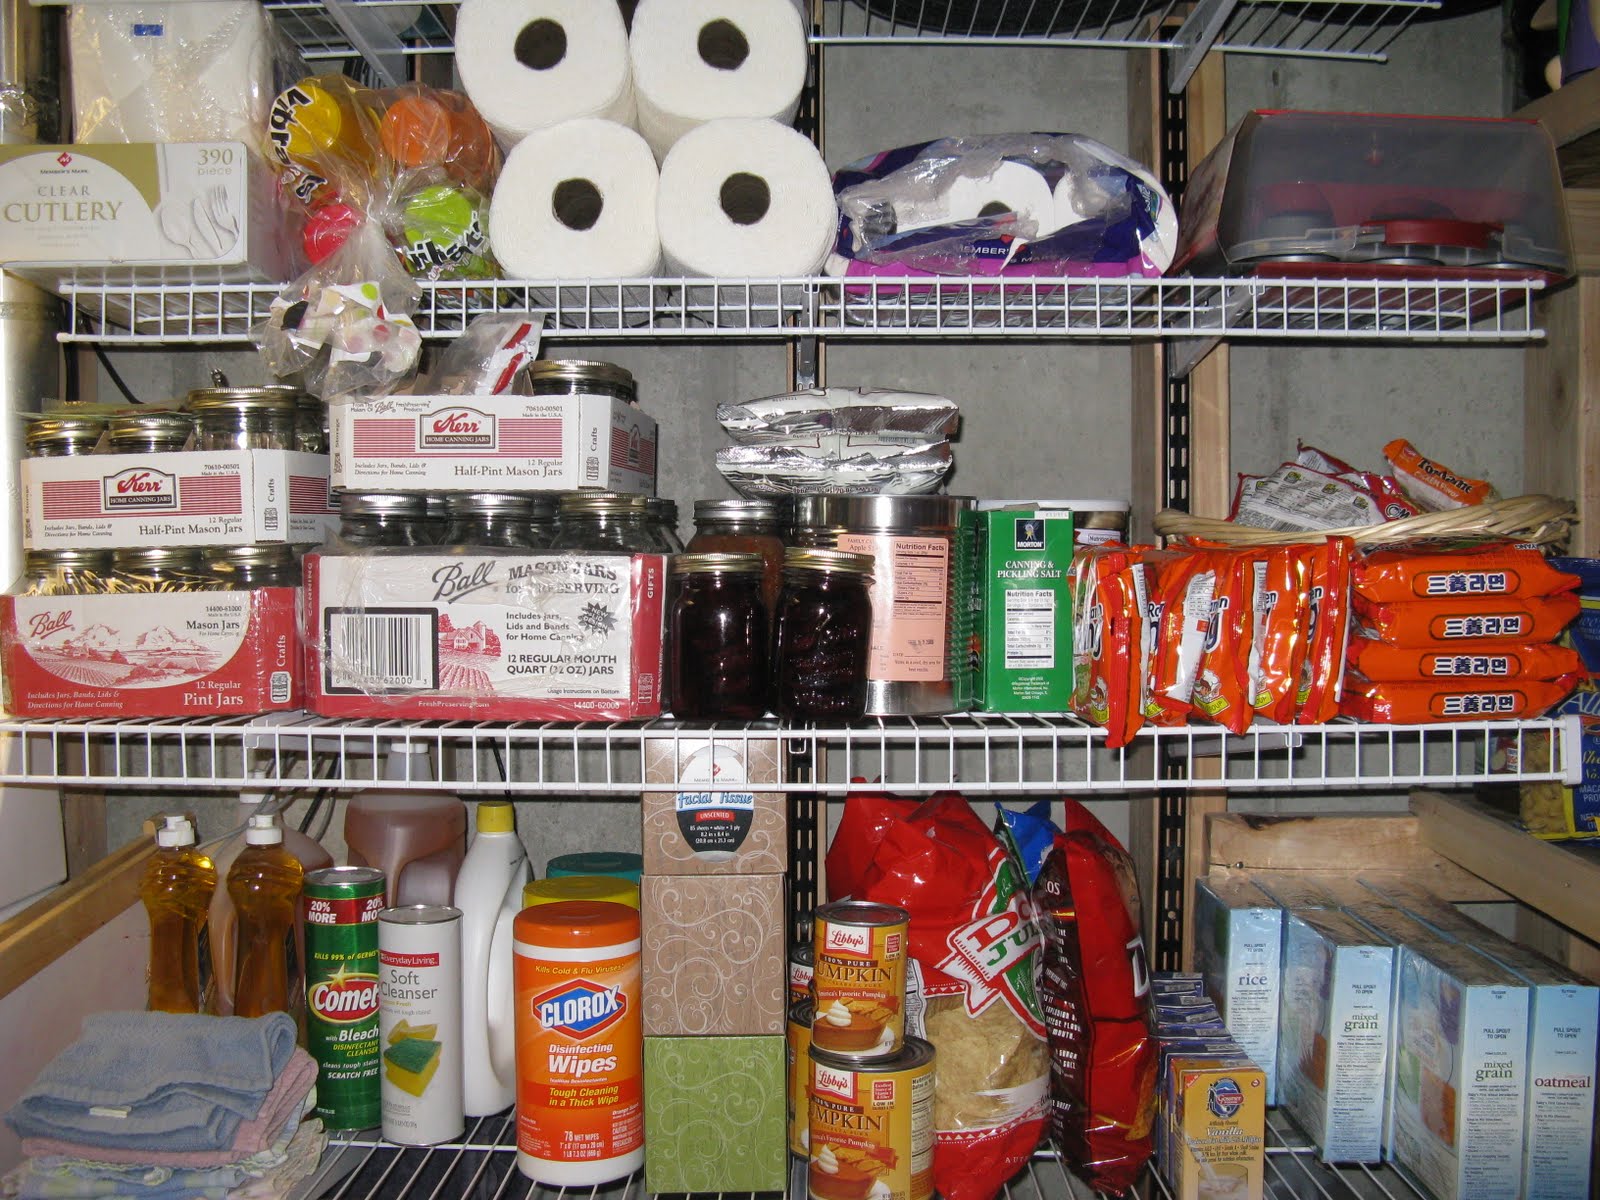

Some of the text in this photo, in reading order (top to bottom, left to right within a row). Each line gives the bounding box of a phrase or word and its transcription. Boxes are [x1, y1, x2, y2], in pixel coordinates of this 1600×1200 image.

[198, 149, 233, 166] 390
[197, 166, 233, 176] piece
[37, 185, 90, 197] CLEAR
[4, 201, 123, 223] CUTLERY
[433, 412, 480, 433] Kerr
[538, 459, 563, 467] Regular
[455, 465, 563, 477] Half-Pint Mason Jars
[118, 472, 162, 493] Kerr
[156, 495, 171, 504] JARS
[219, 517, 242, 525] Regular
[139, 523, 243, 536] Half-Pint Mason Jars
[1005, 560, 1046, 569] CANNING
[997, 570, 1062, 579] PICKLING SALT
[432, 560, 498, 604] Ball
[506, 612, 541, 620] Includes
[29, 610, 73, 639] Ball
[186, 620, 240, 630] Mason Jars
[276, 635, 286, 667] Crafts
[508, 654, 617, 664] 12 REGULAR MOUTH
[507, 665, 546, 675] QUART
[566, 666, 587, 676] OZ)
[589, 666, 614, 676] JARS
[208, 681, 241, 691] Regular
[28, 701, 61, 709] Directions
[63, 701, 73, 710] for
[95, 701, 123, 710] Canning
[184, 693, 243, 708] Pint Jars
[311, 901, 331, 912] 20%
[308, 911, 337, 924] MORE
[831, 930, 864, 947] Libby's
[315, 952, 328, 960] KILLS
[347, 952, 355, 960] of
[412, 956, 437, 965] Living
[824, 956, 843, 965] 100%
[536, 965, 550, 973] Kills
[816, 960, 893, 982] UMPKIN
[391, 970, 419, 985] Soft
[1238, 973, 1268, 986] rice
[381, 982, 437, 1000] Cleanser
[818, 990, 838, 998] merica's
[862, 991, 886, 999] Pumpkin
[314, 985, 378, 1011] Comet
[541, 985, 620, 1028] CLOROX
[1352, 1013, 1378, 1021] mixed
[1344, 1019, 1378, 1032] grain
[339, 1024, 378, 1041] Bleach
[333, 1040, 378, 1051] DISINFECTANT
[549, 1044, 613, 1054] Disinfecting
[346, 1046, 378, 1057] CLEANSER
[343, 1061, 361, 1069] tough
[363, 1059, 378, 1067] stains
[549, 1055, 617, 1078] Wipes
[1484, 1060, 1512, 1069] mixed
[328, 1068, 378, 1079] SCRATCH FREE
[1475, 1068, 1512, 1081] grain
[818, 1070, 849, 1090] Libby's
[1535, 1076, 1591, 1088] oatmeal
[549, 1086, 619, 1098] Tough Cleaning
[569, 1098, 594, 1106] Thick
[598, 1096, 619, 1105] Wipe
[832, 1103, 854, 1113] PURE
[812, 1104, 883, 1131] MPKIN
[565, 1131, 573, 1141] 78
[585, 1132, 599, 1140] WIPES
[1207, 1127, 1243, 1136] Vanilla
[848, 1137, 875, 1149] Pumpkin
